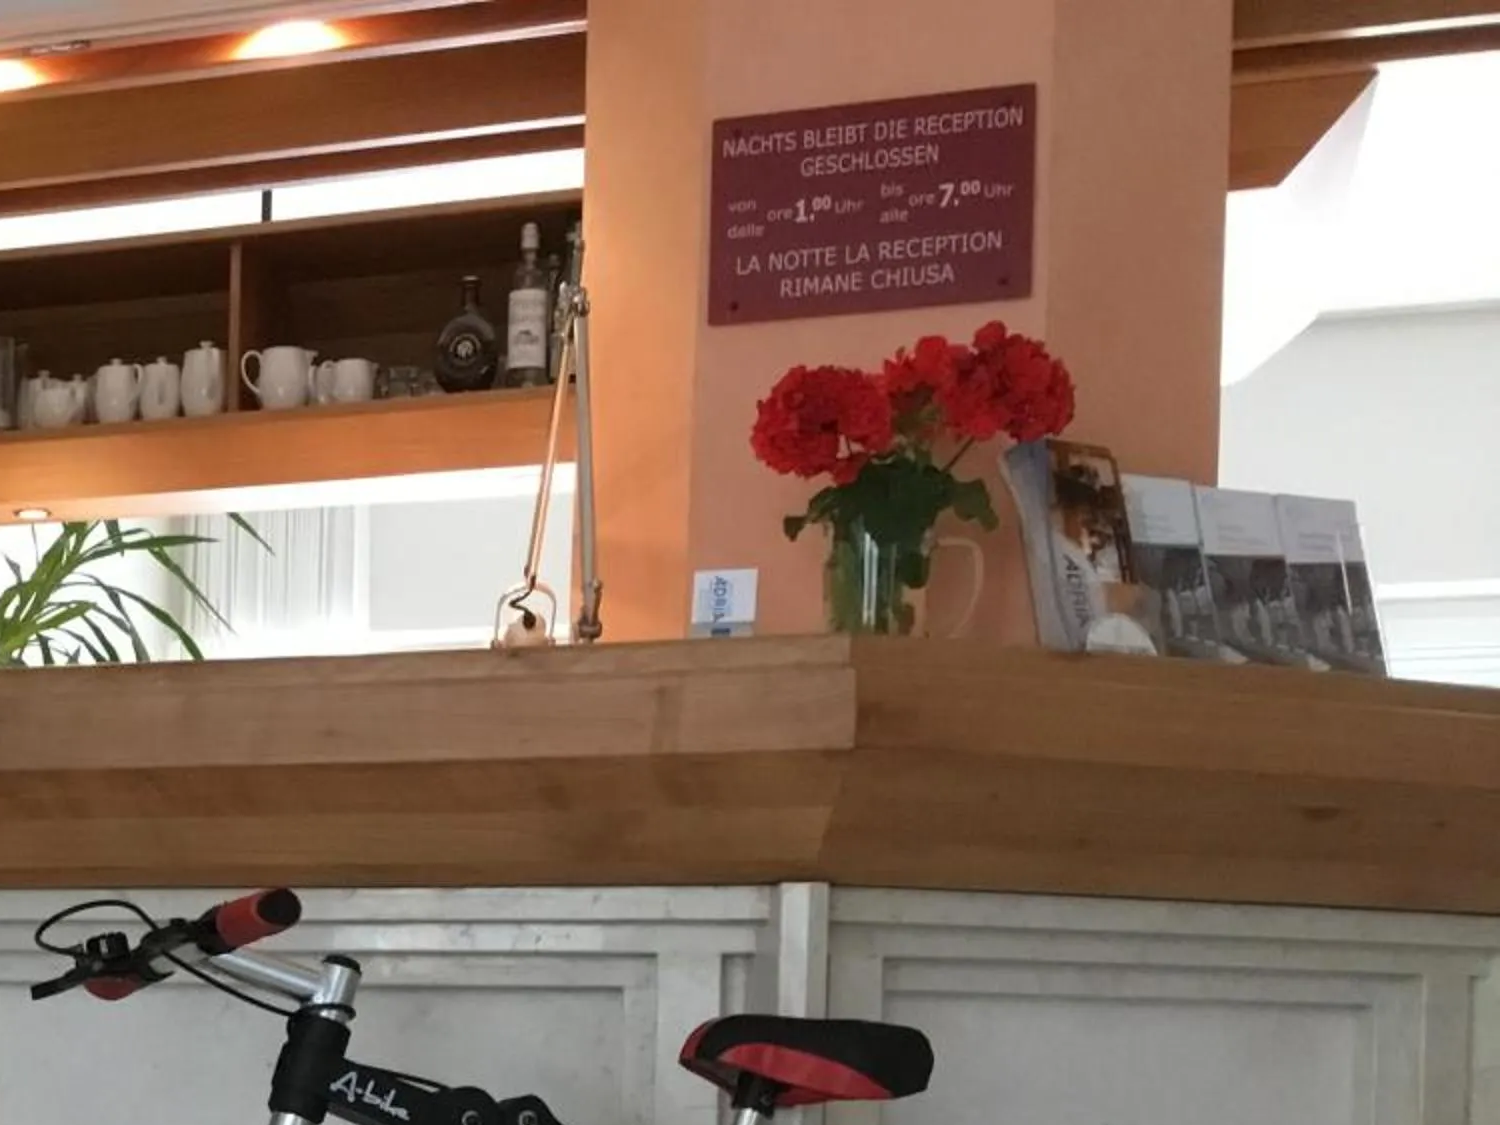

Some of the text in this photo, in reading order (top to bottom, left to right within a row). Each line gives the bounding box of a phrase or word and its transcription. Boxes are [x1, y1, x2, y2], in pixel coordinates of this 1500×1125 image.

[722, 105, 1024, 159] NACHTS BLEIBT DIE RECEPTION
[800, 143, 940, 178] GESCHLOSSEN
[880, 182, 904, 198] bis
[983, 181, 1014, 198] Uhr
[727, 200, 757, 213] von
[835, 199, 864, 214] Uhr
[736, 230, 1002, 276] LA NOTTE LA RECEPTION
[780, 262, 955, 298] RIMANE CHIUSA
